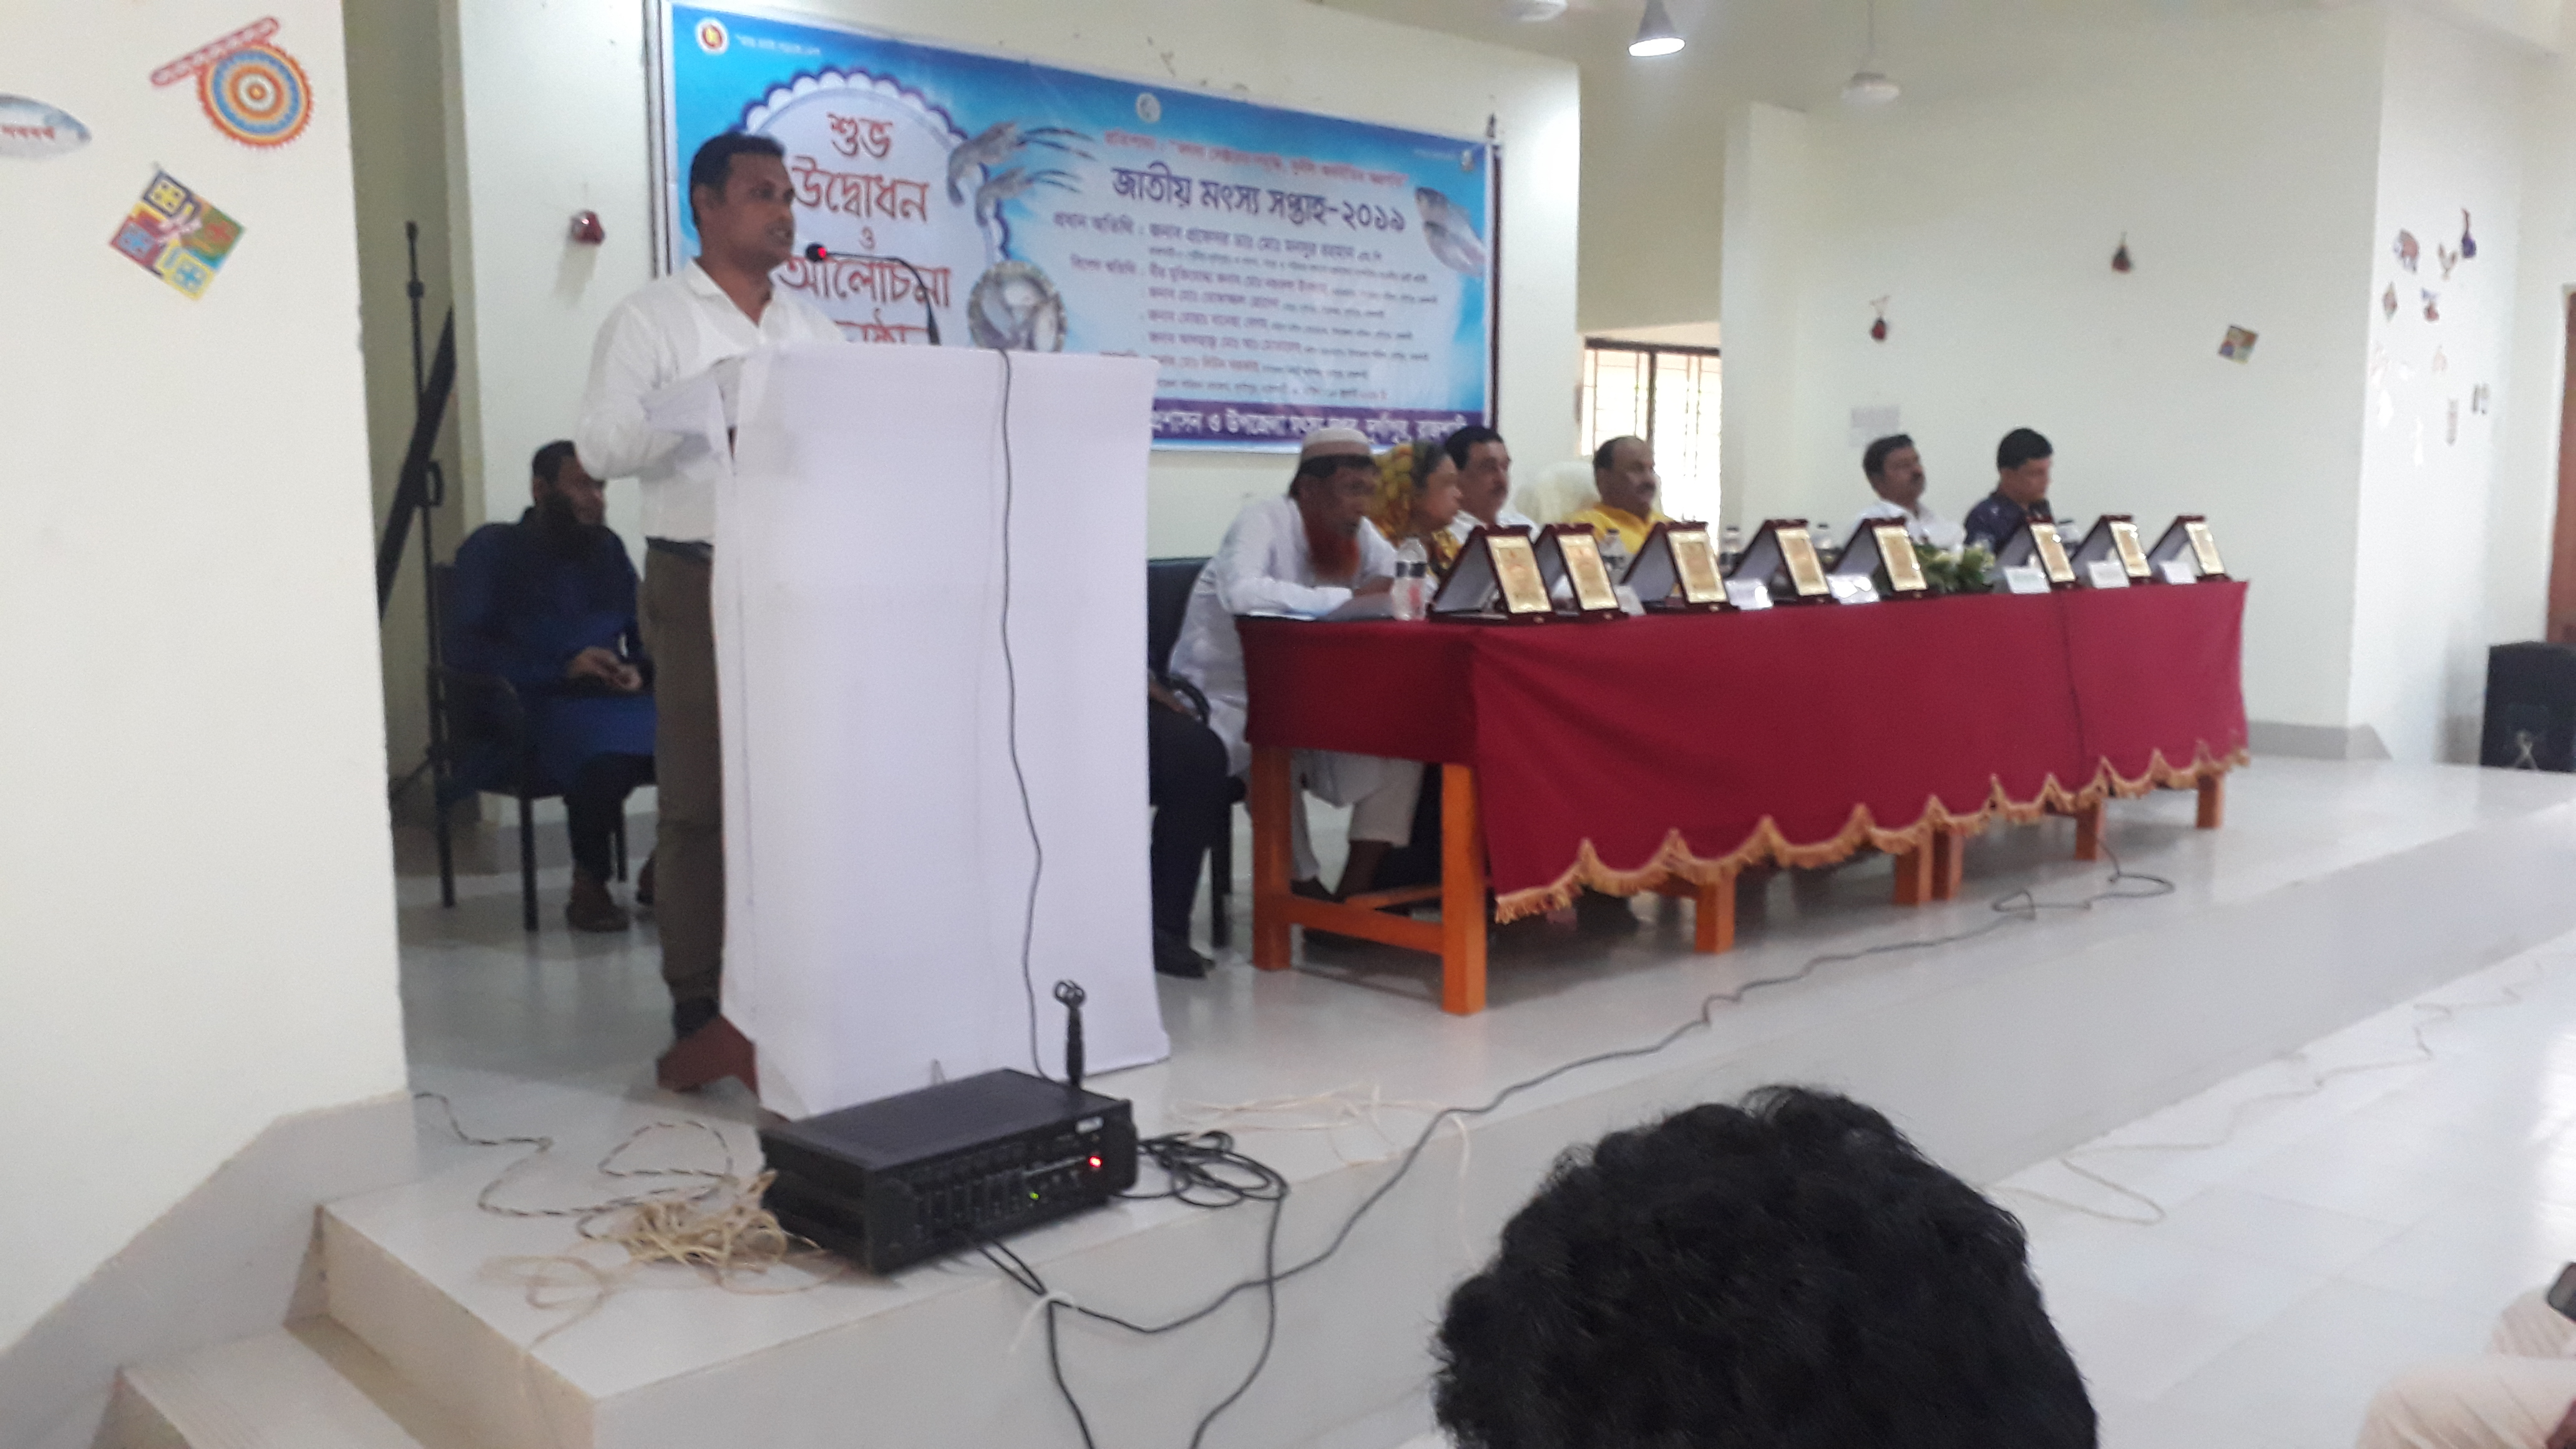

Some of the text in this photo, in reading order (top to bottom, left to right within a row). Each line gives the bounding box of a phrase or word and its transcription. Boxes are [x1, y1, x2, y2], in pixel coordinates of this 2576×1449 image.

[827, 112, 892, 159] শুভ
[791, 155, 929, 223] উদ্বোধন
[1111, 160, 1193, 207] জাতীয়
[1199, 178, 1261, 217] মৎস্য
[859, 225, 877, 250] ও
[773, 256, 950, 308] আলোচনা
